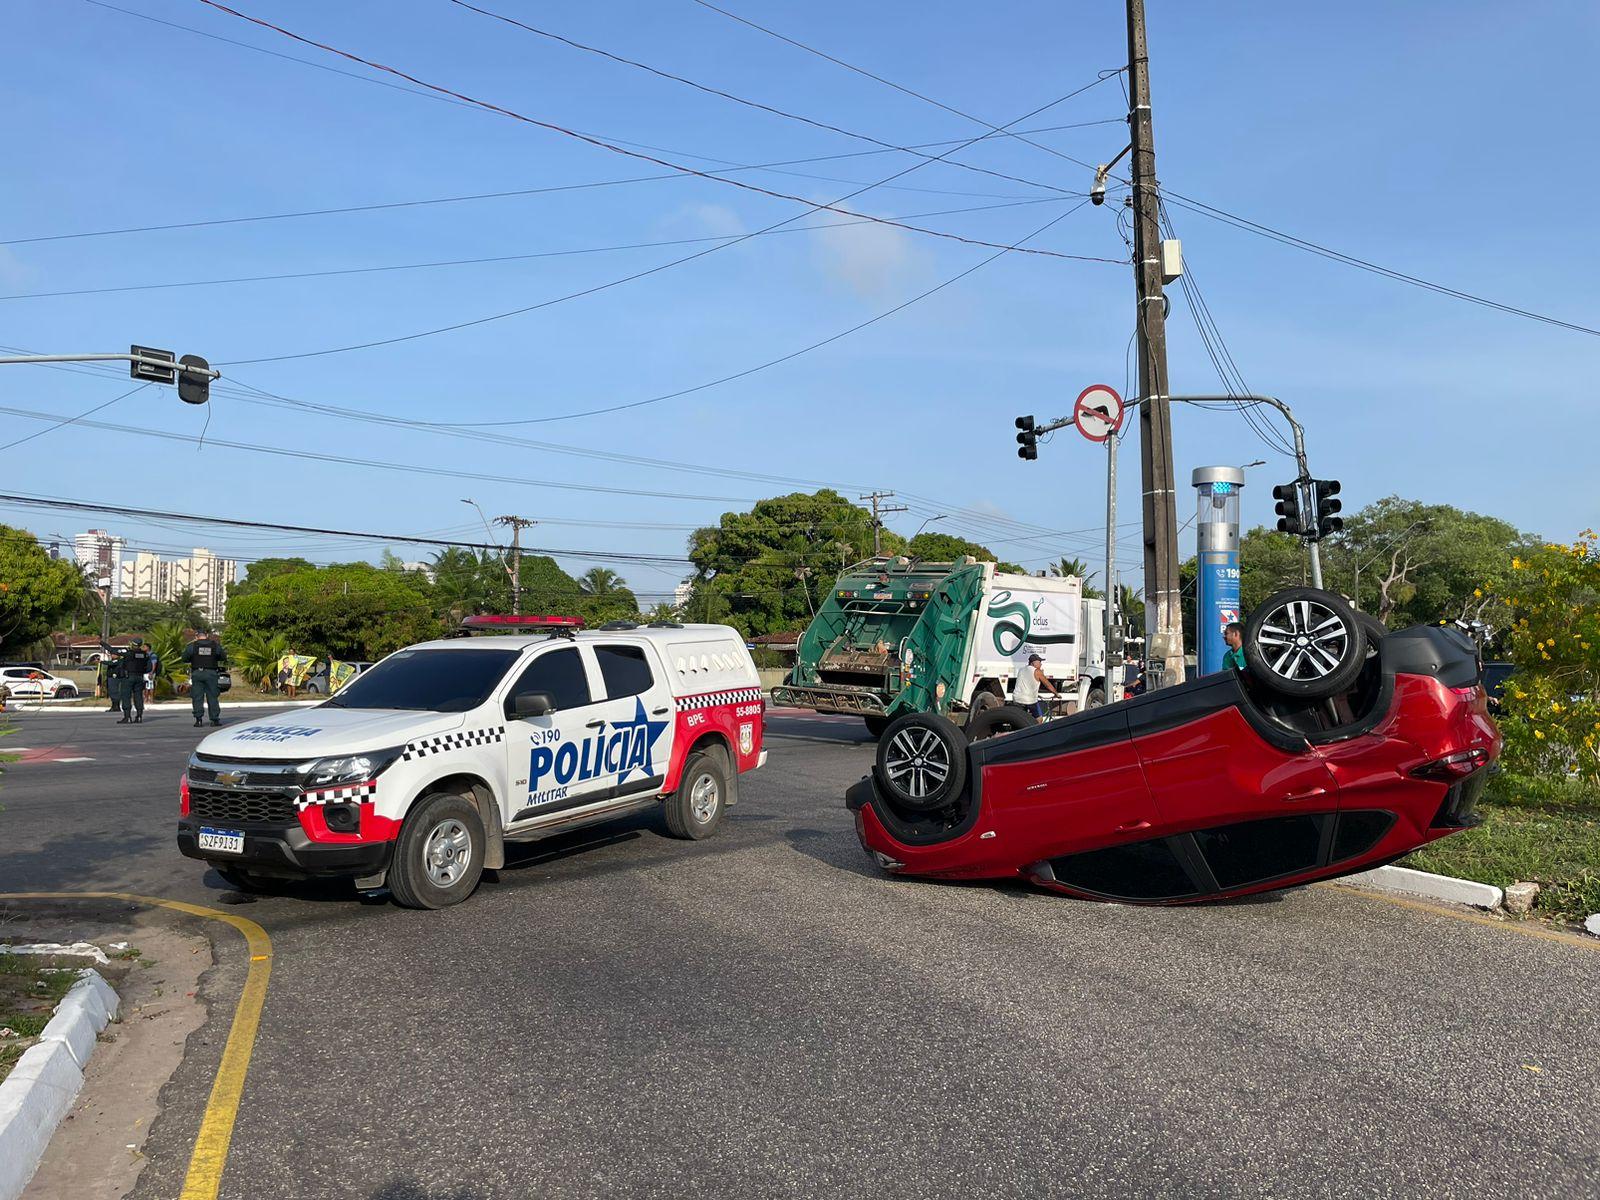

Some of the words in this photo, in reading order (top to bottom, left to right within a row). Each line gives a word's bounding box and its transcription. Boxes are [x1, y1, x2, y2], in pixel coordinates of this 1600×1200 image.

[1033, 616, 1048, 626] ciclus
[687, 713, 705, 727] BPE
[541, 728, 561, 744] 190
[528, 724, 647, 792] POLÍCIA
[526, 786, 568, 806] MILITAR
[203, 835, 239, 850] SZF9131
